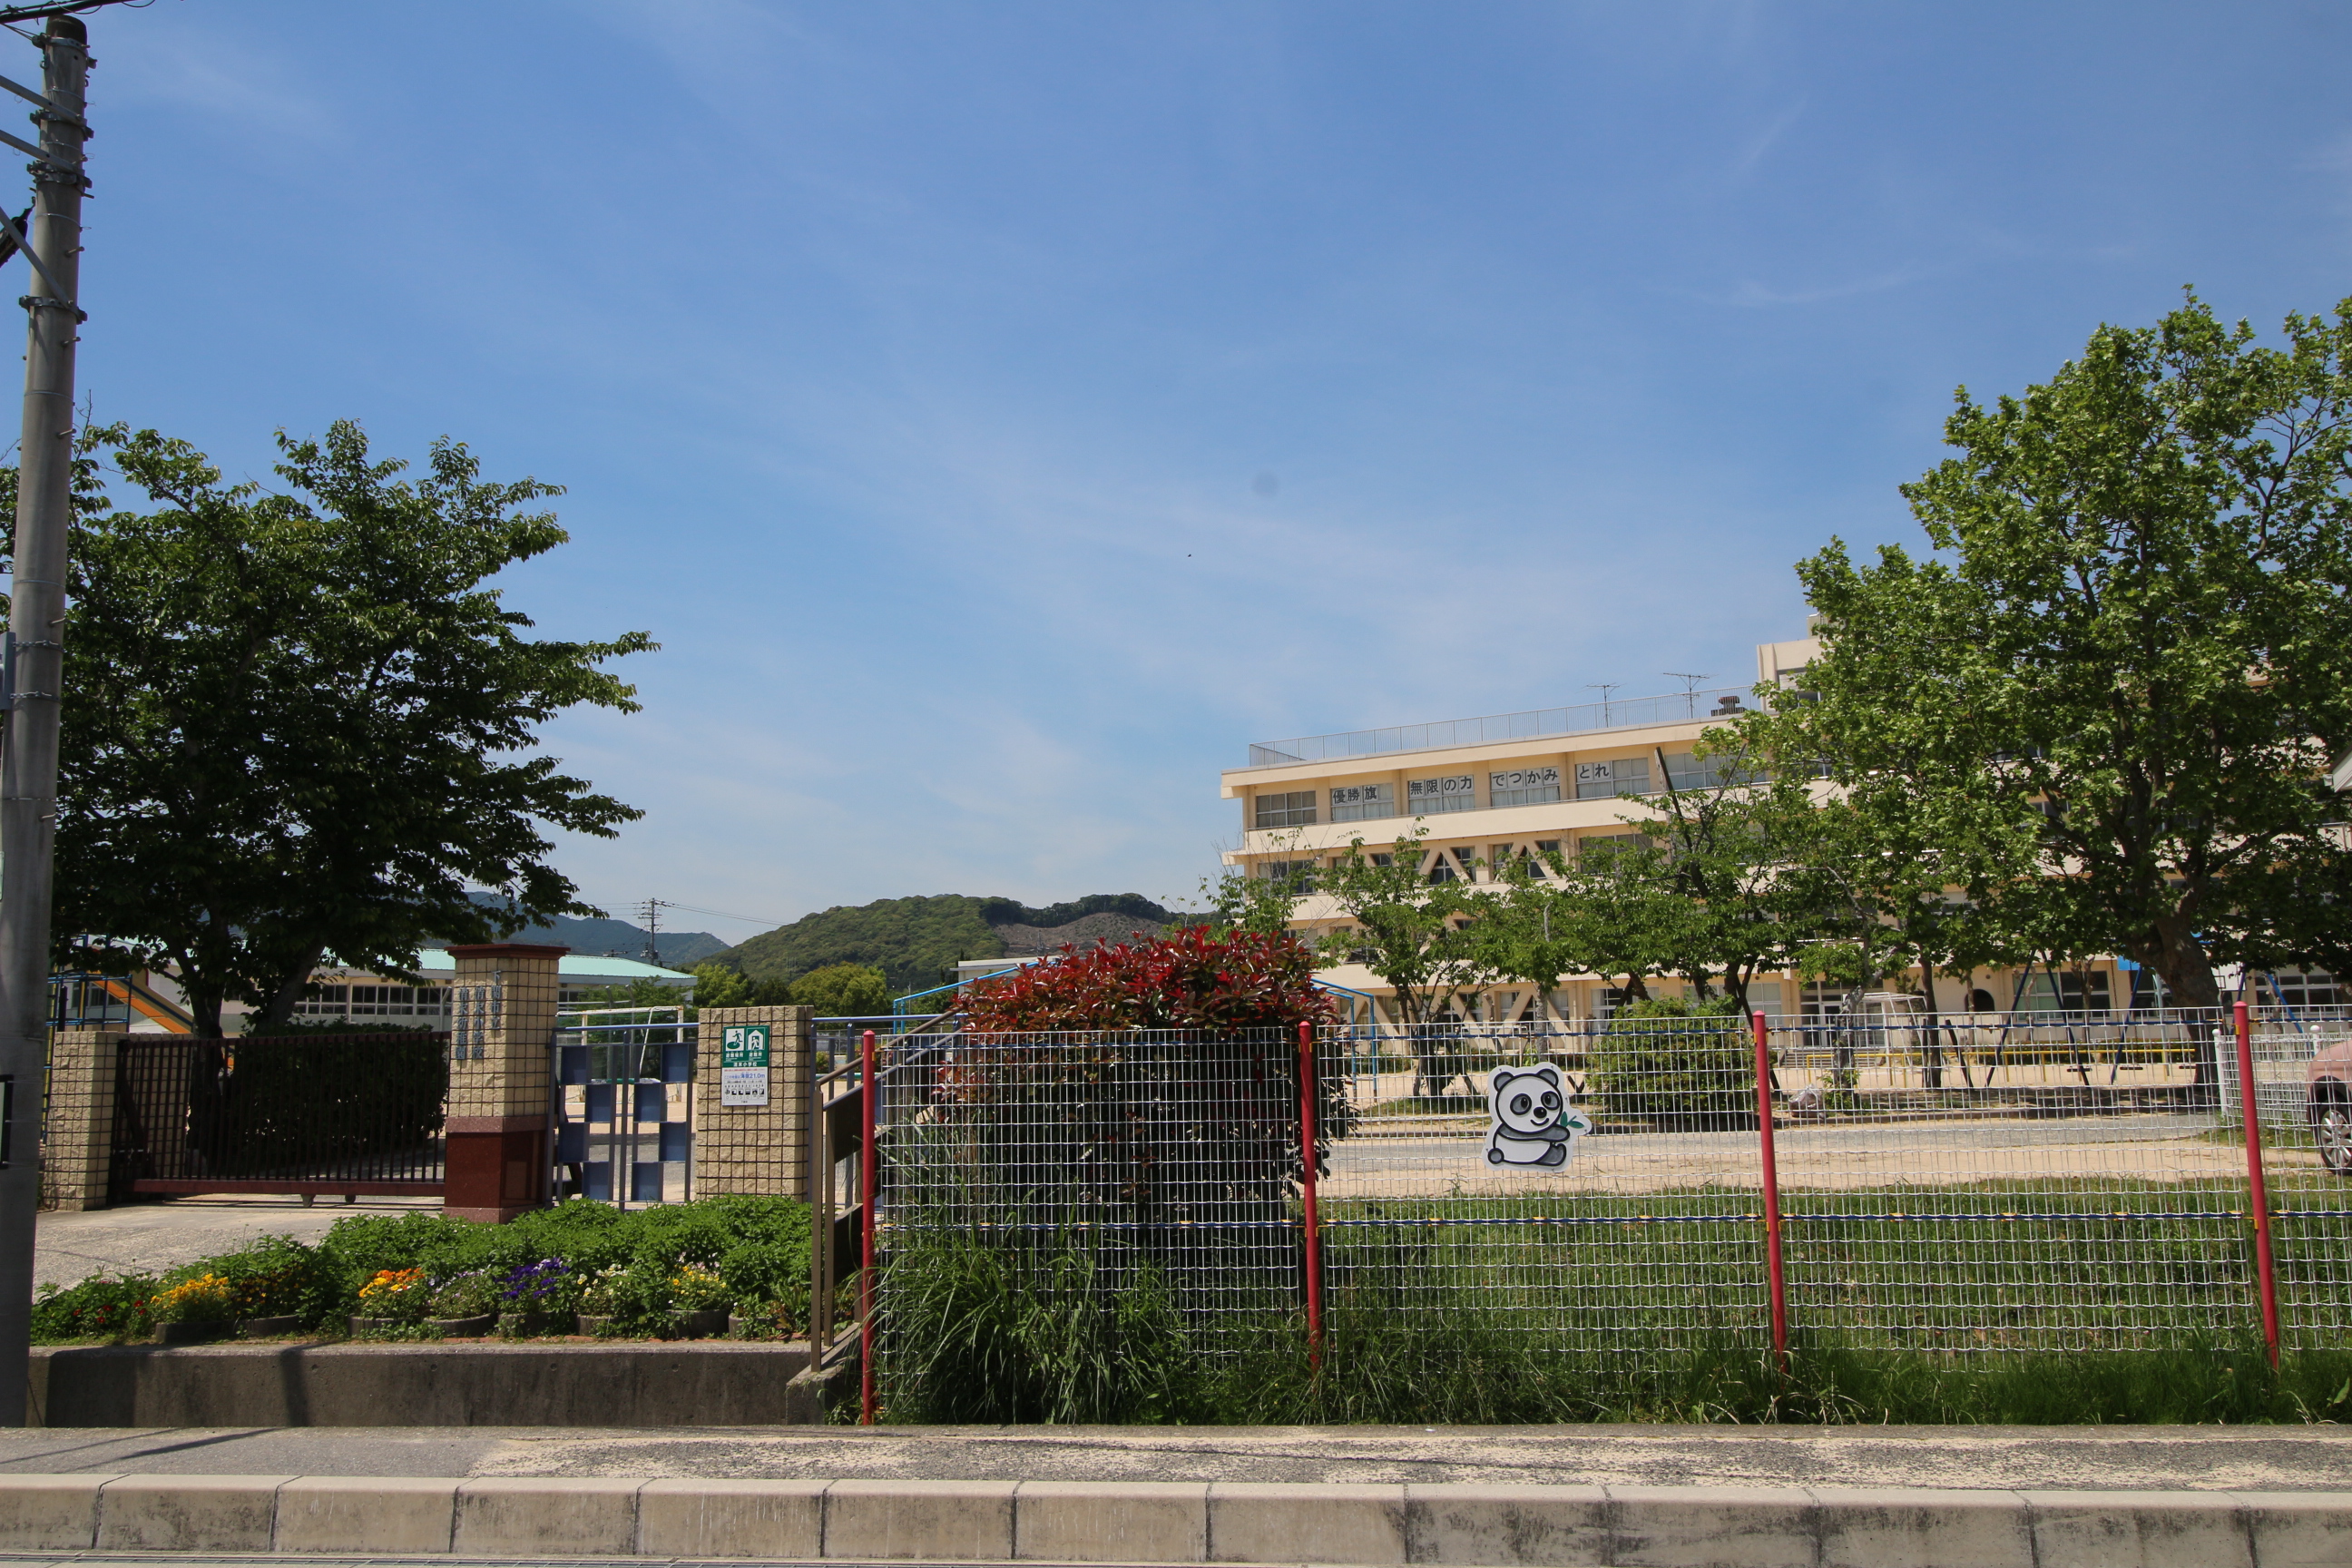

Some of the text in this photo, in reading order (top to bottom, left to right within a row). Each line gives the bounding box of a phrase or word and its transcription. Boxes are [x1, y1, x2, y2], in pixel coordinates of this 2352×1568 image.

[1332, 764, 1610, 805] 優勝旗 無限の力 でつかみ とれ
[491, 970, 502, 1029] 下関市立
